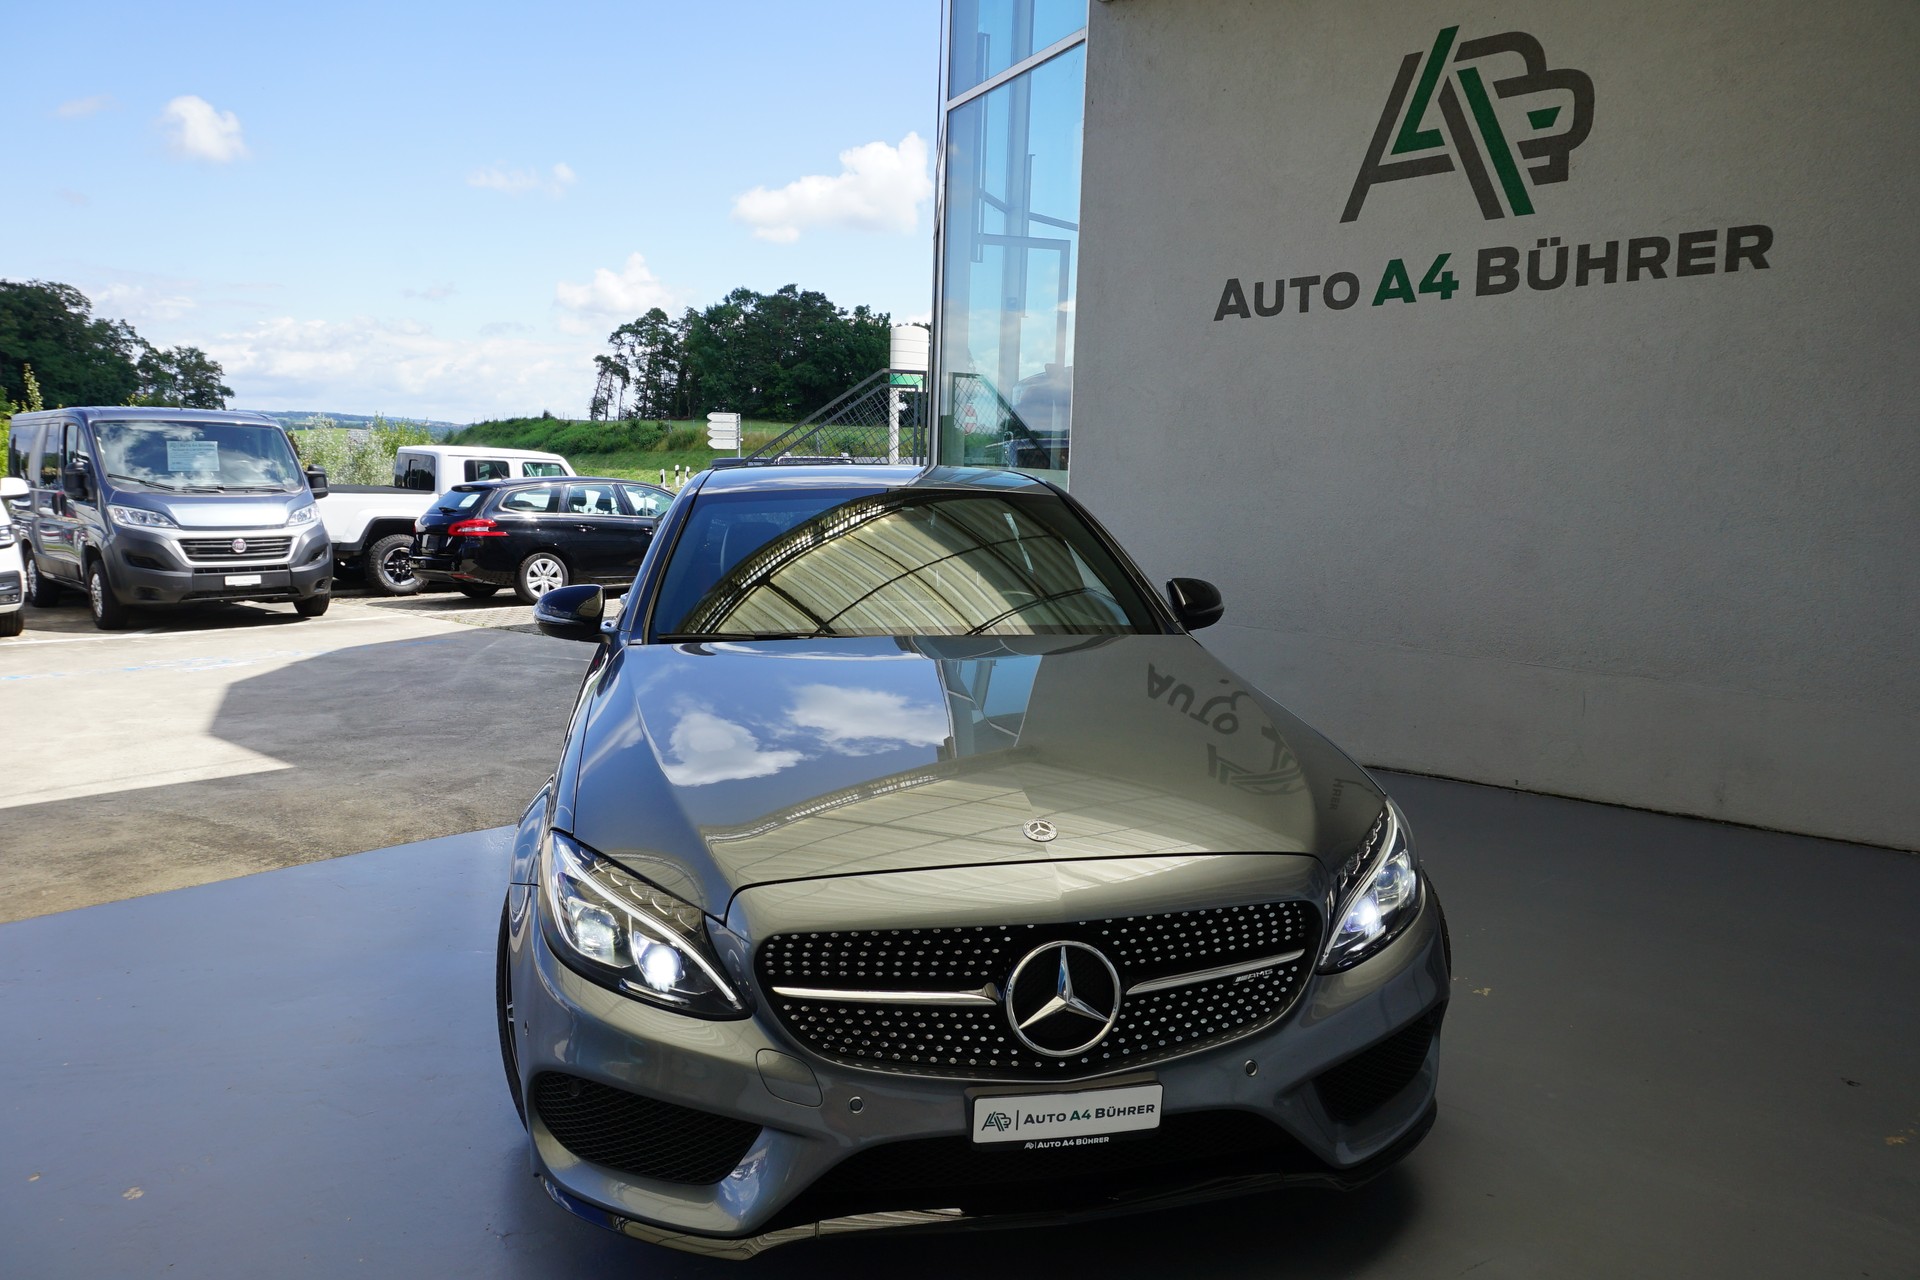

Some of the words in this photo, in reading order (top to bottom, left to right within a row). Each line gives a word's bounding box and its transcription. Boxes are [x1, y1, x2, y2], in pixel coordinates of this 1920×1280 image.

[1213, 271, 1361, 322] AUTO
[1371, 252, 1460, 307] A4
[1475, 223, 1775, 297] BÜHRER
[1023, 1113, 1067, 1125] AUTO
[1070, 1109, 1091, 1121] A4
[1095, 1104, 1155, 1119] BÜHRER
[1037, 1141, 1061, 1149] AUTO
[1062, 1139, 1075, 1147] A4
[1076, 1136, 1110, 1146] BÜHRER
